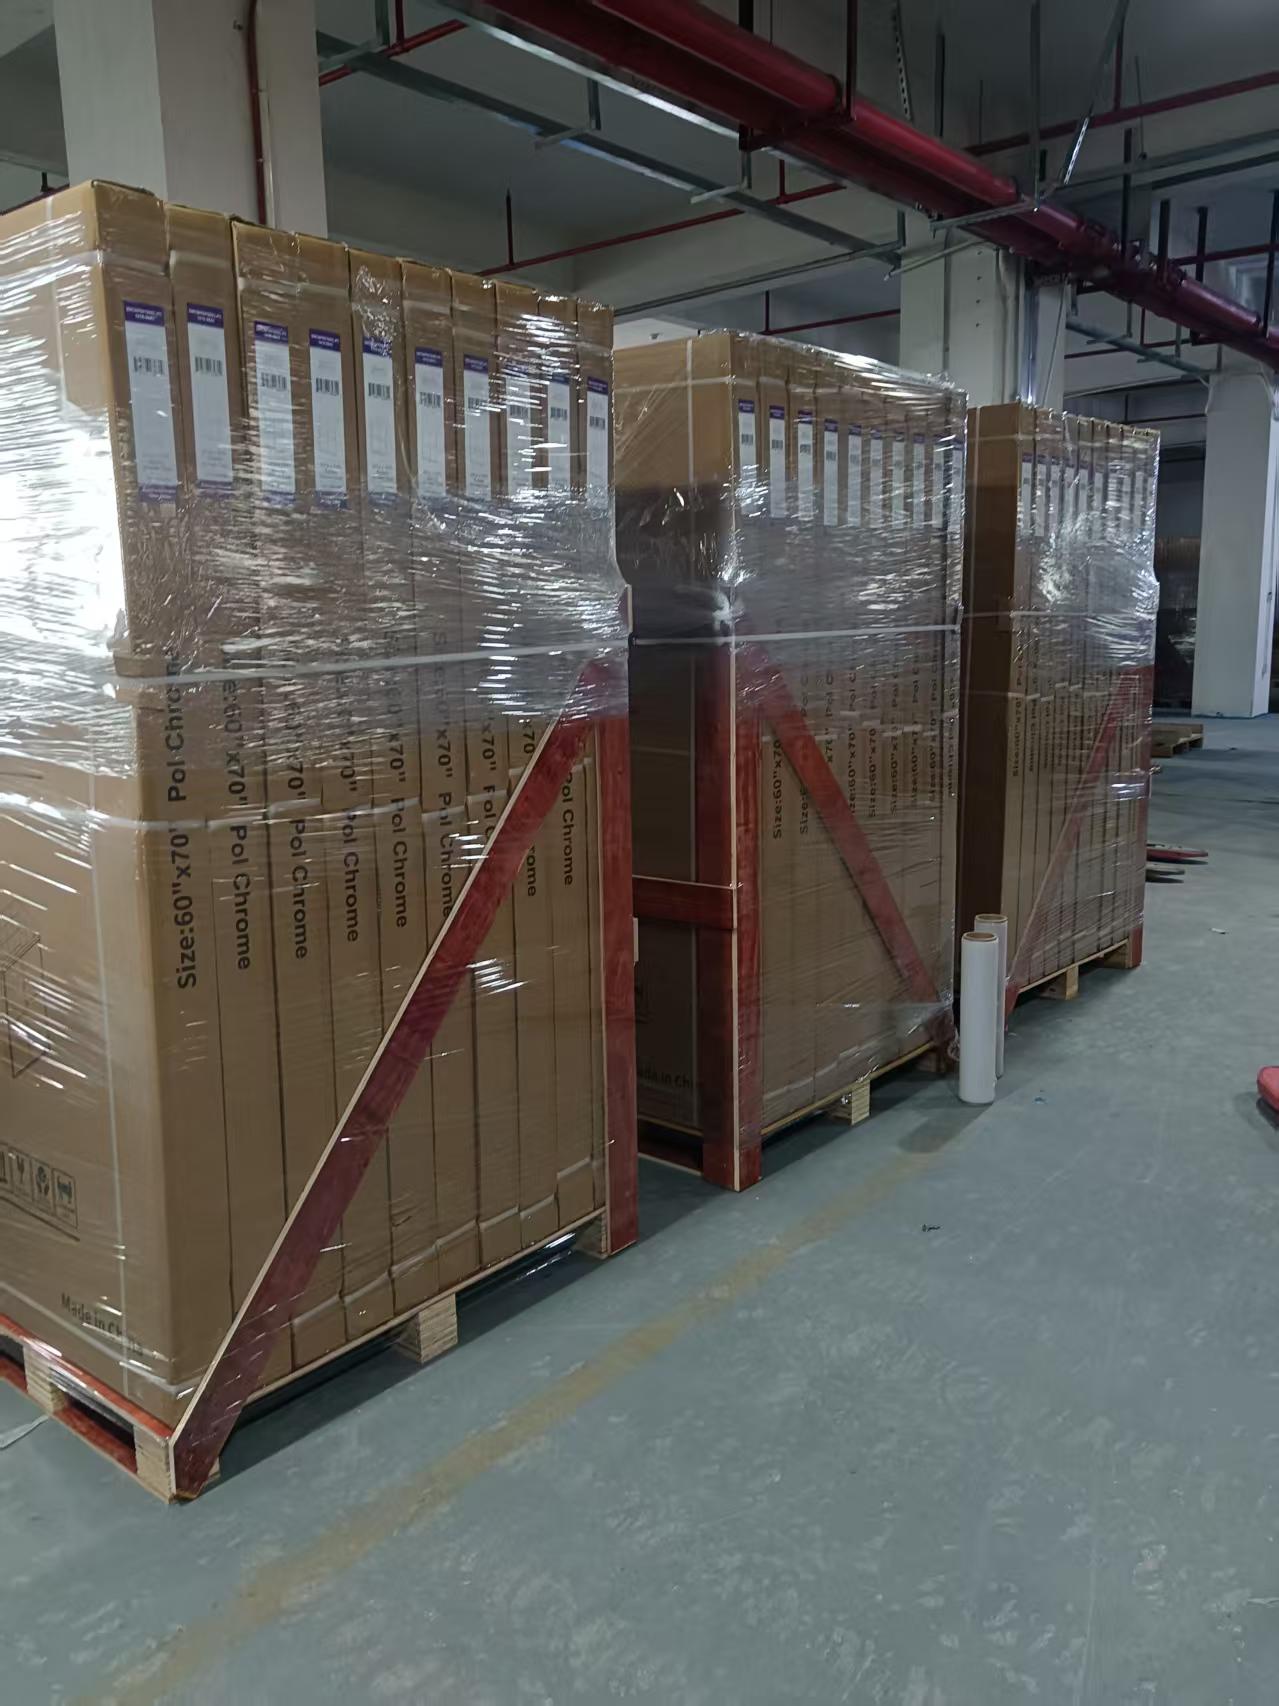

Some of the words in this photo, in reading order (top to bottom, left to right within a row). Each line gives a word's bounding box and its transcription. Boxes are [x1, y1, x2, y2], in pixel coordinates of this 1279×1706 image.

[167, 759, 187, 802] Pol
[230, 825, 249, 865] Pol
[289, 818, 306, 857] Pol
[561, 809, 575, 887] Chrome
[232, 873, 251, 970] Chrome
[291, 864, 308, 960] Chrome
[343, 851, 359, 942] Chrome
[393, 841, 408, 928] Chrome
